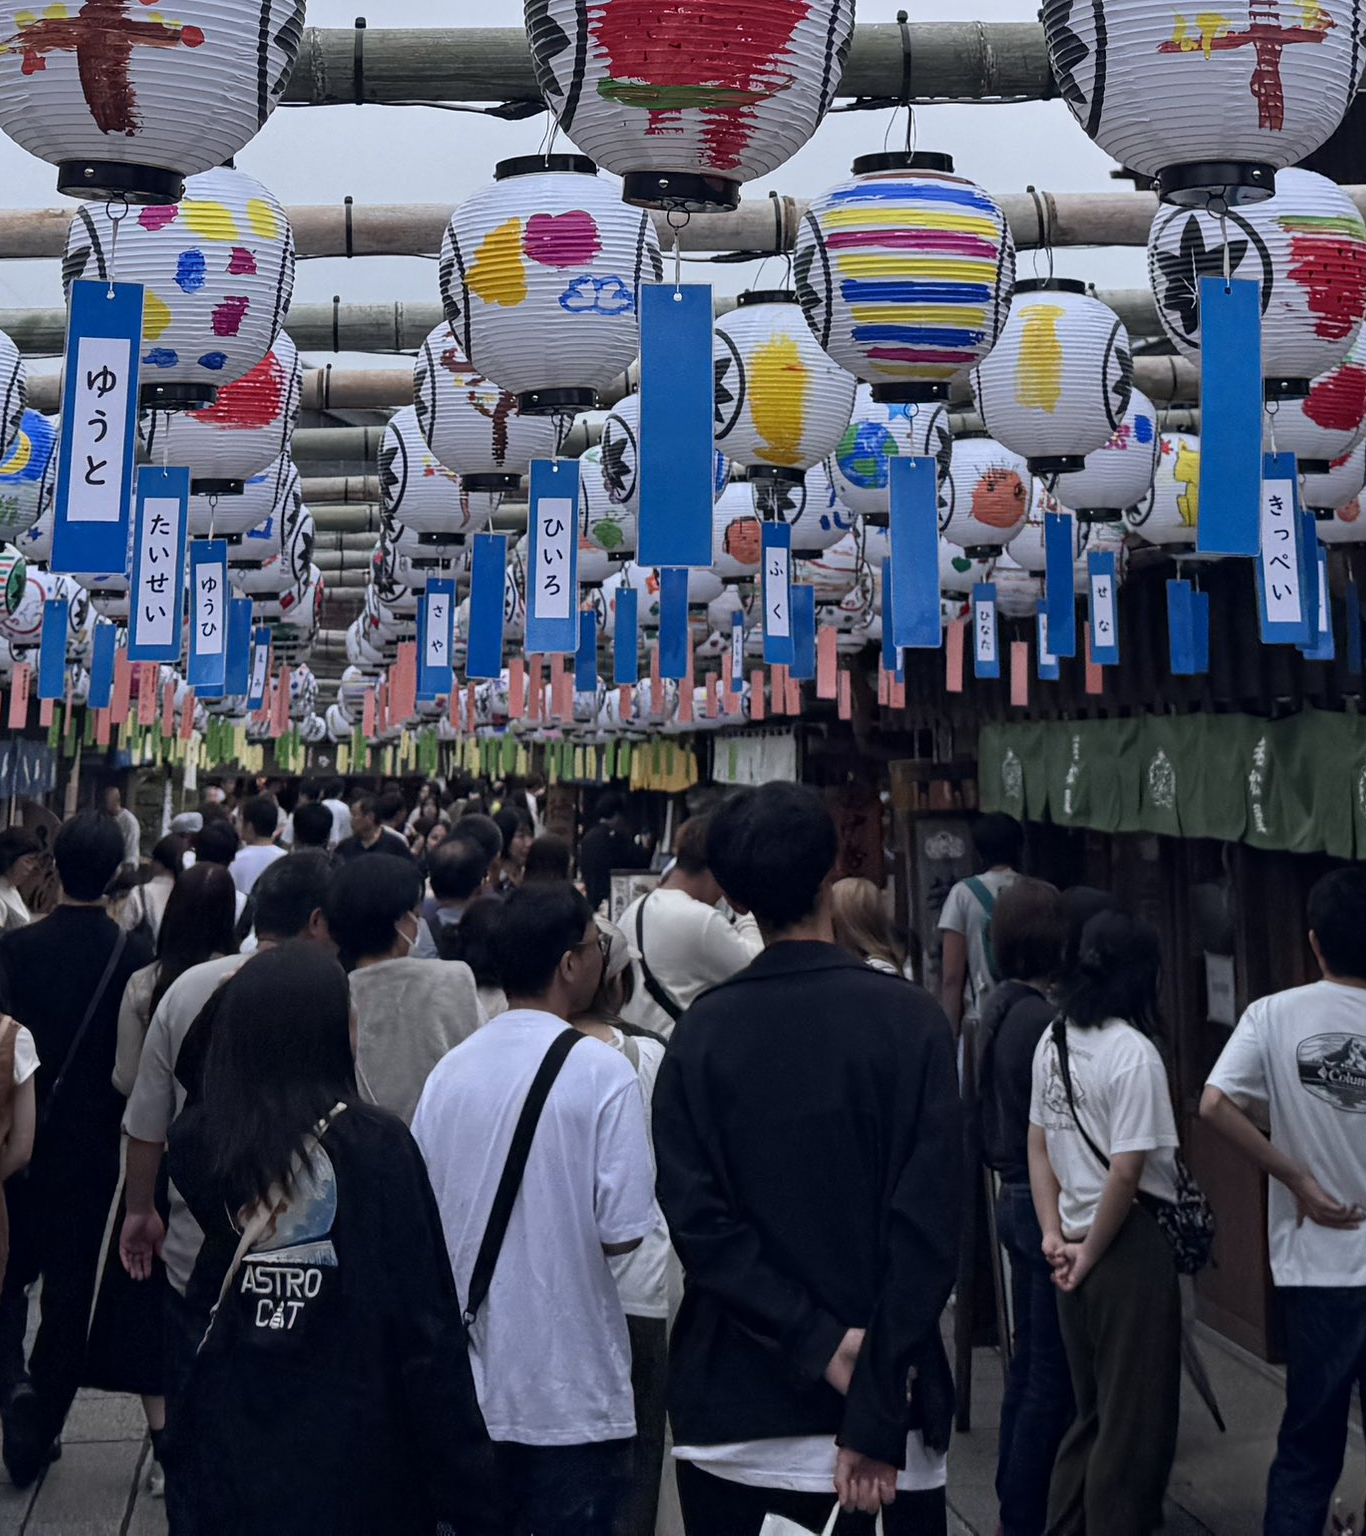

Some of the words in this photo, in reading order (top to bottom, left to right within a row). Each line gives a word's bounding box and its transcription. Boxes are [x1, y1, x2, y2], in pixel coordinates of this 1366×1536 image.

[85, 365, 117, 485] ゆうと
[146, 513, 170, 622] たいせい
[543, 518, 564, 595] ひいろ
[1268, 494, 1292, 601] きっぺい
[201, 577, 217, 636] ゆうひ
[769, 561, 784, 619] ふく
[1096, 586, 1110, 633] せな
[431, 606, 444, 653] さや
[979, 610, 991, 651] ひなた
[240, 1264, 323, 1298] ASTRO
[255, 1299, 305, 1330] CAT
